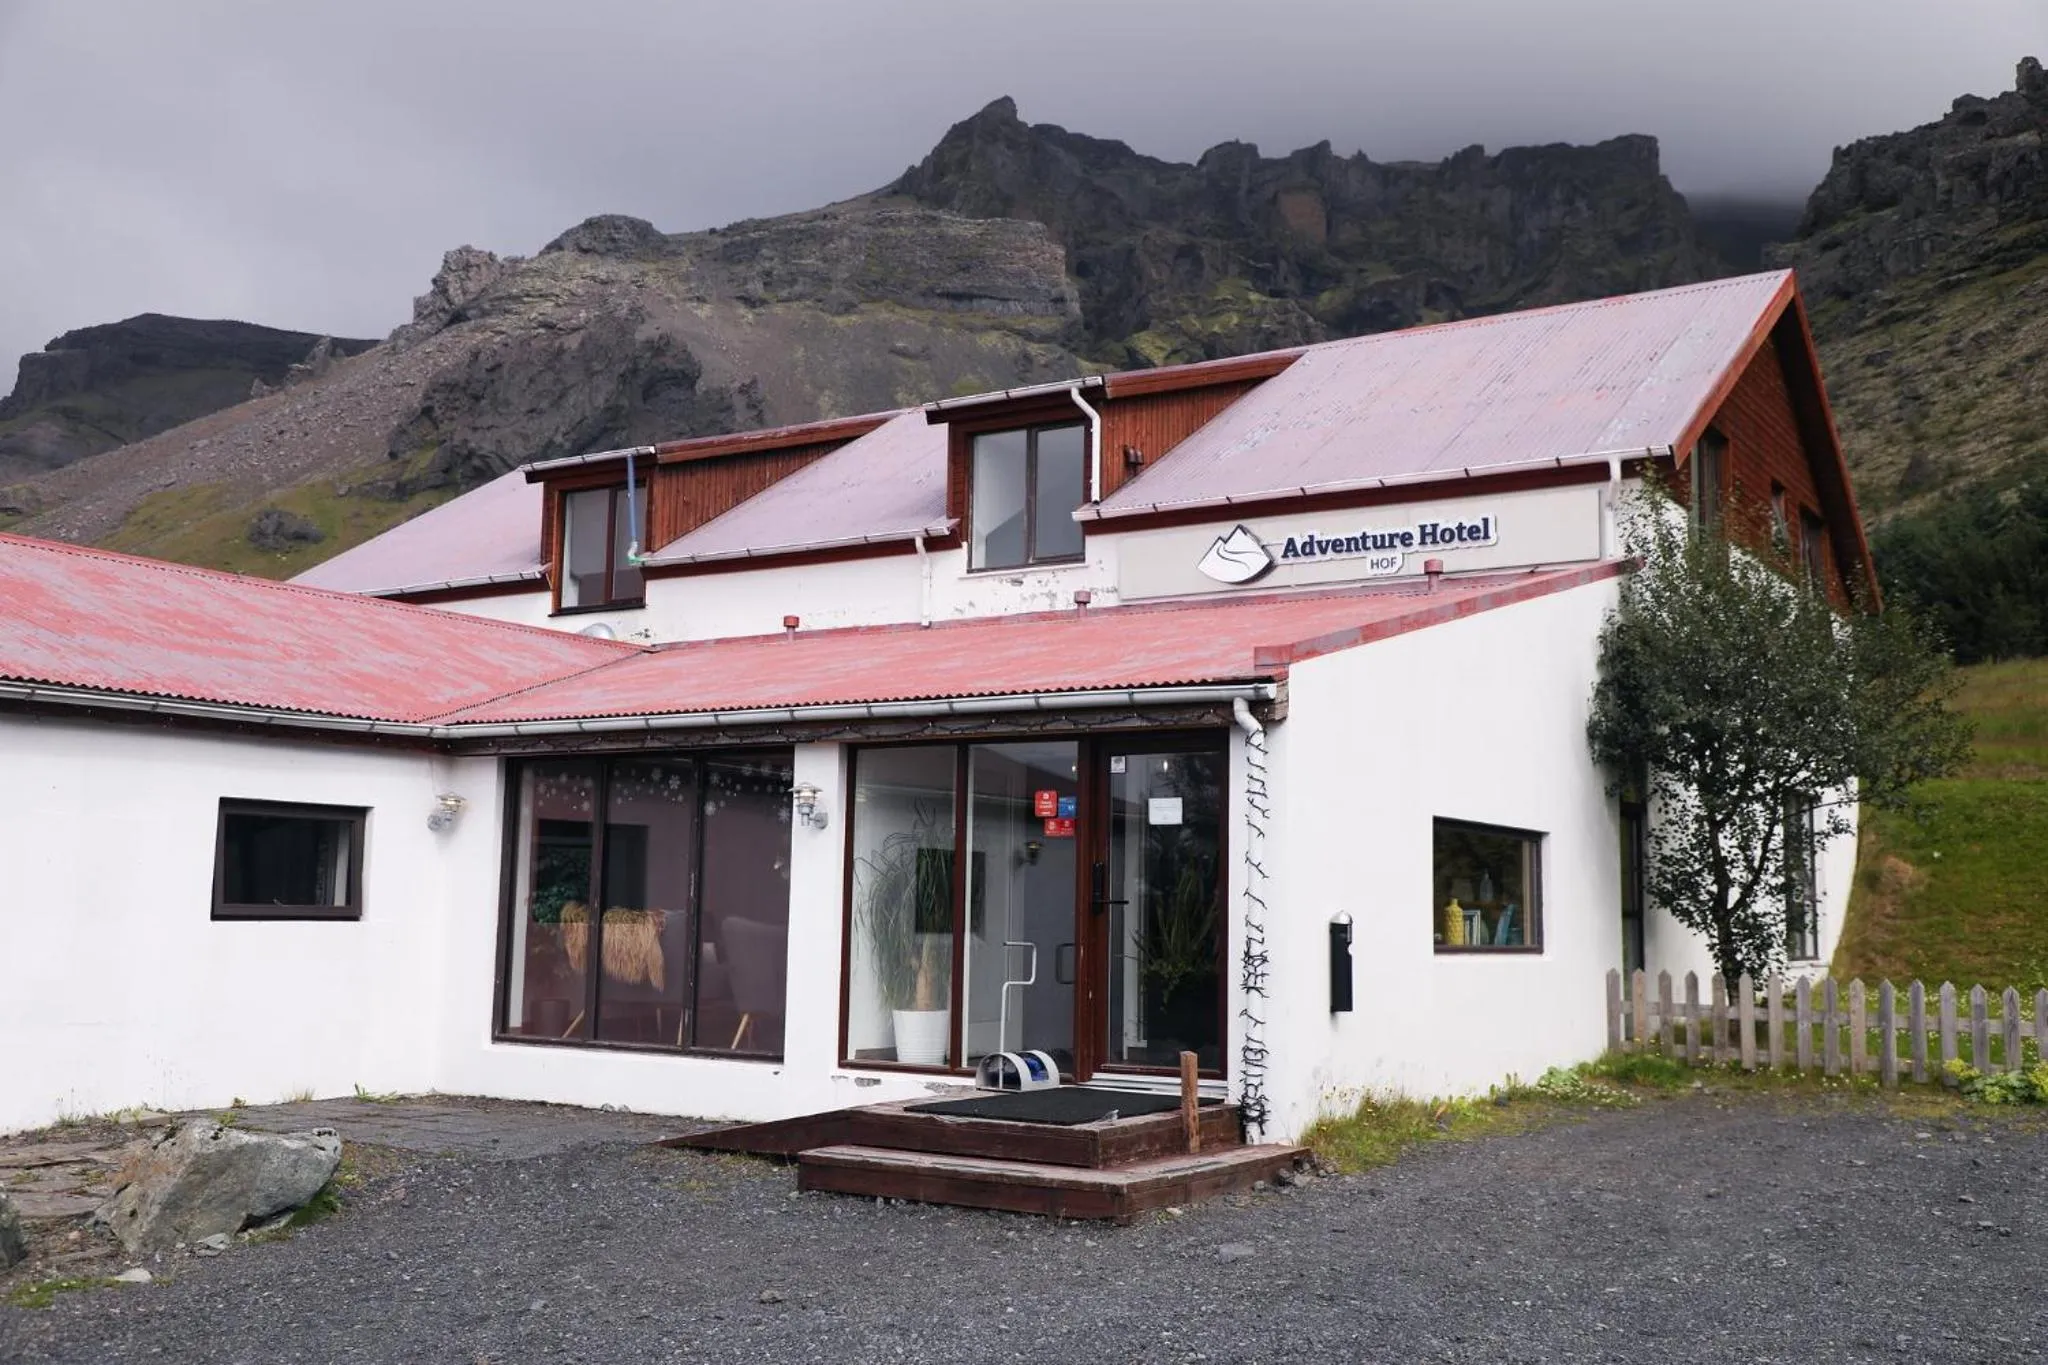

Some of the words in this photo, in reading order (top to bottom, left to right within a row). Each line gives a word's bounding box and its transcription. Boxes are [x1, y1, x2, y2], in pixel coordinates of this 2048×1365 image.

[1281, 532, 1413, 558] Adventure
[1418, 518, 1491, 545] Hotel
[1370, 556, 1397, 570] HOF
